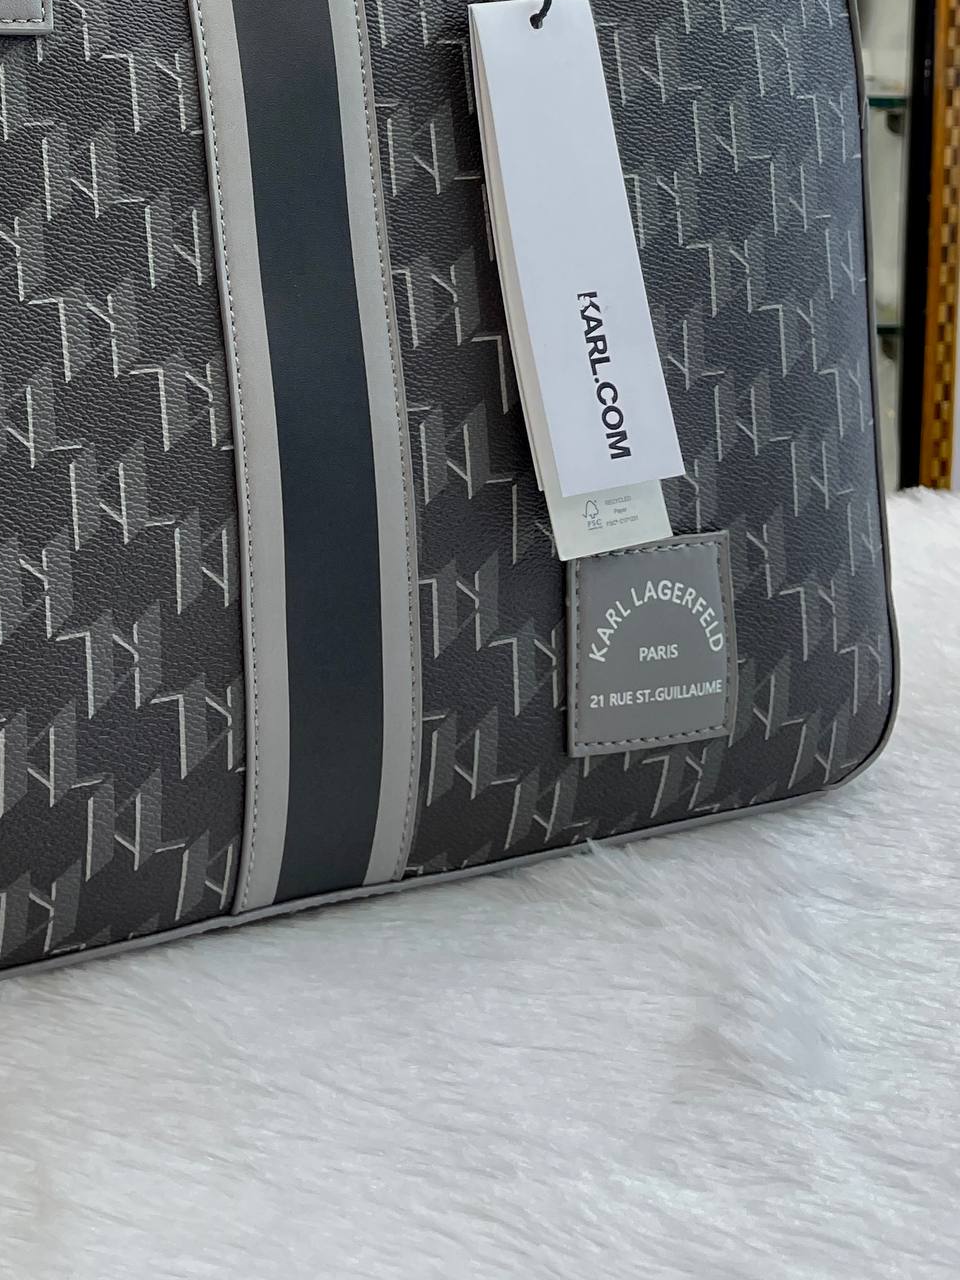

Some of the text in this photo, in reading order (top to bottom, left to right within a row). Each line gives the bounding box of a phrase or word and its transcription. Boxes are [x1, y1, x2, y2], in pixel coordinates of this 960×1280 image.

[577, 291, 632, 460] KARL.COM
[589, 580, 724, 662] KARL LAGERFELD
[639, 644, 678, 661] PARIS
[590, 695, 604, 708] 21
[609, 691, 633, 707] RUE
